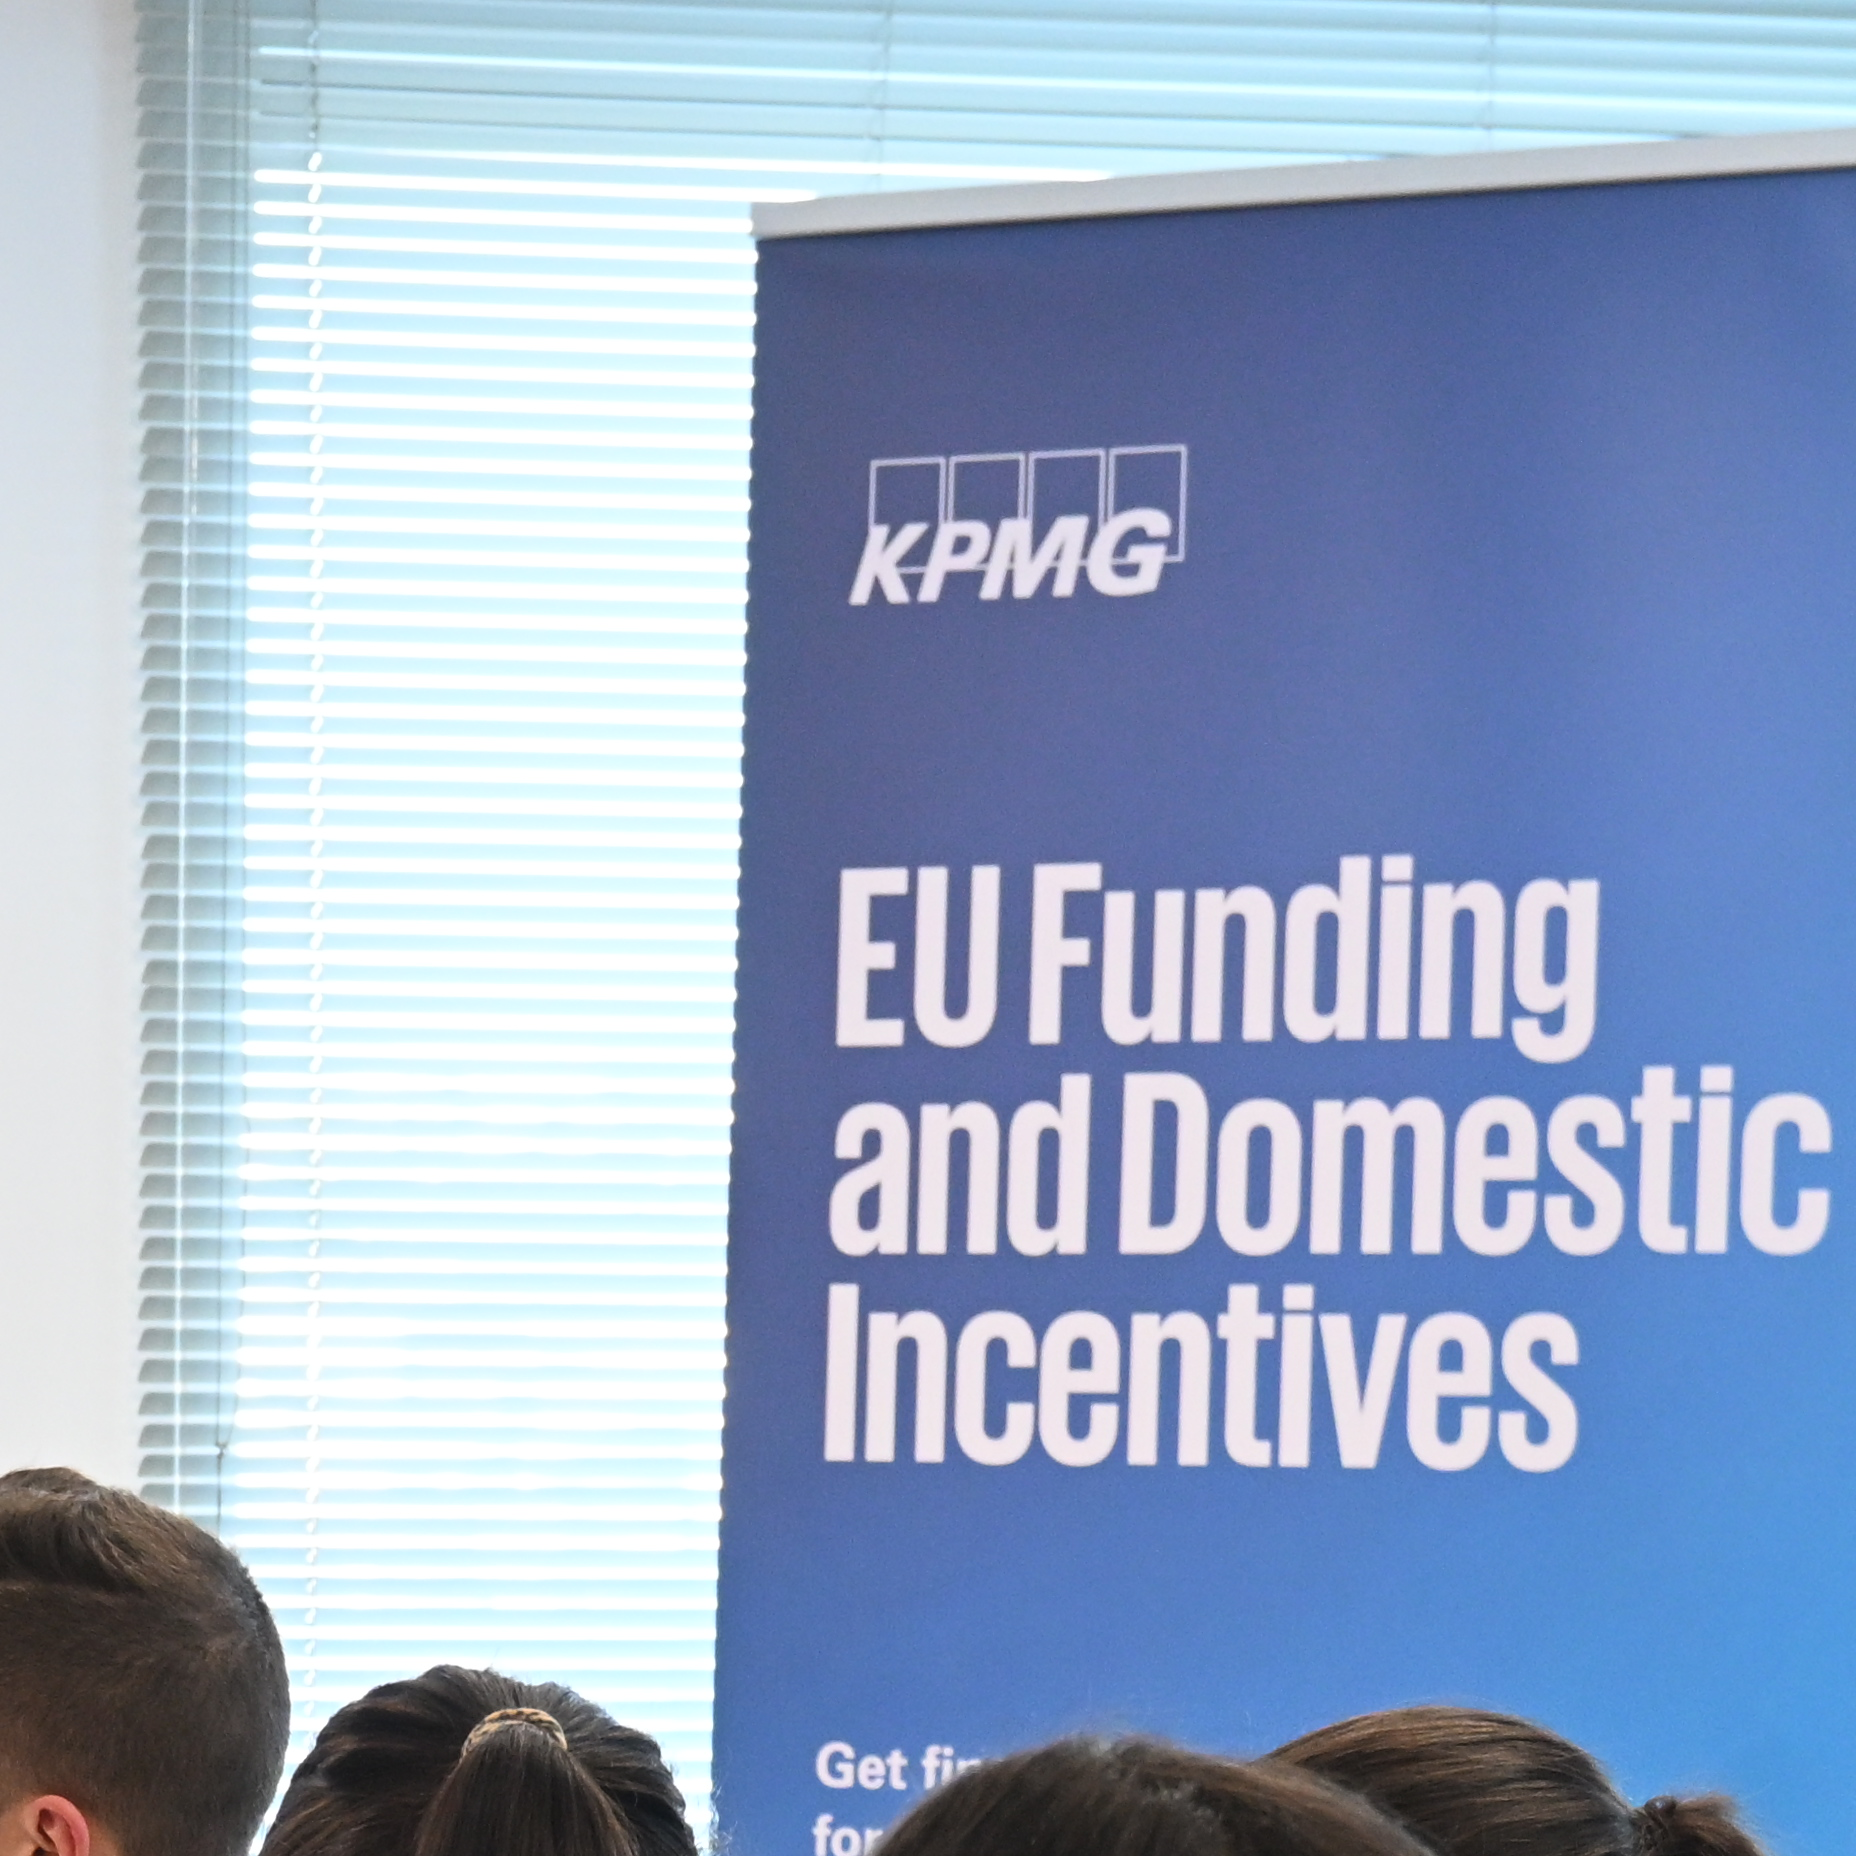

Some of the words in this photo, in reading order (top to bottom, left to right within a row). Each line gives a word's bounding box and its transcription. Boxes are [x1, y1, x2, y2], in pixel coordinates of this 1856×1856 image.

[849, 507, 1174, 605] KPMG
[835, 864, 1001, 1048] EU
[1029, 855, 1600, 1064] Funding
[829, 1073, 1091, 1257] and
[1118, 1065, 1832, 1257] Domestic
[824, 1283, 1581, 1473] Incentives
[815, 1741, 908, 1790] Get
